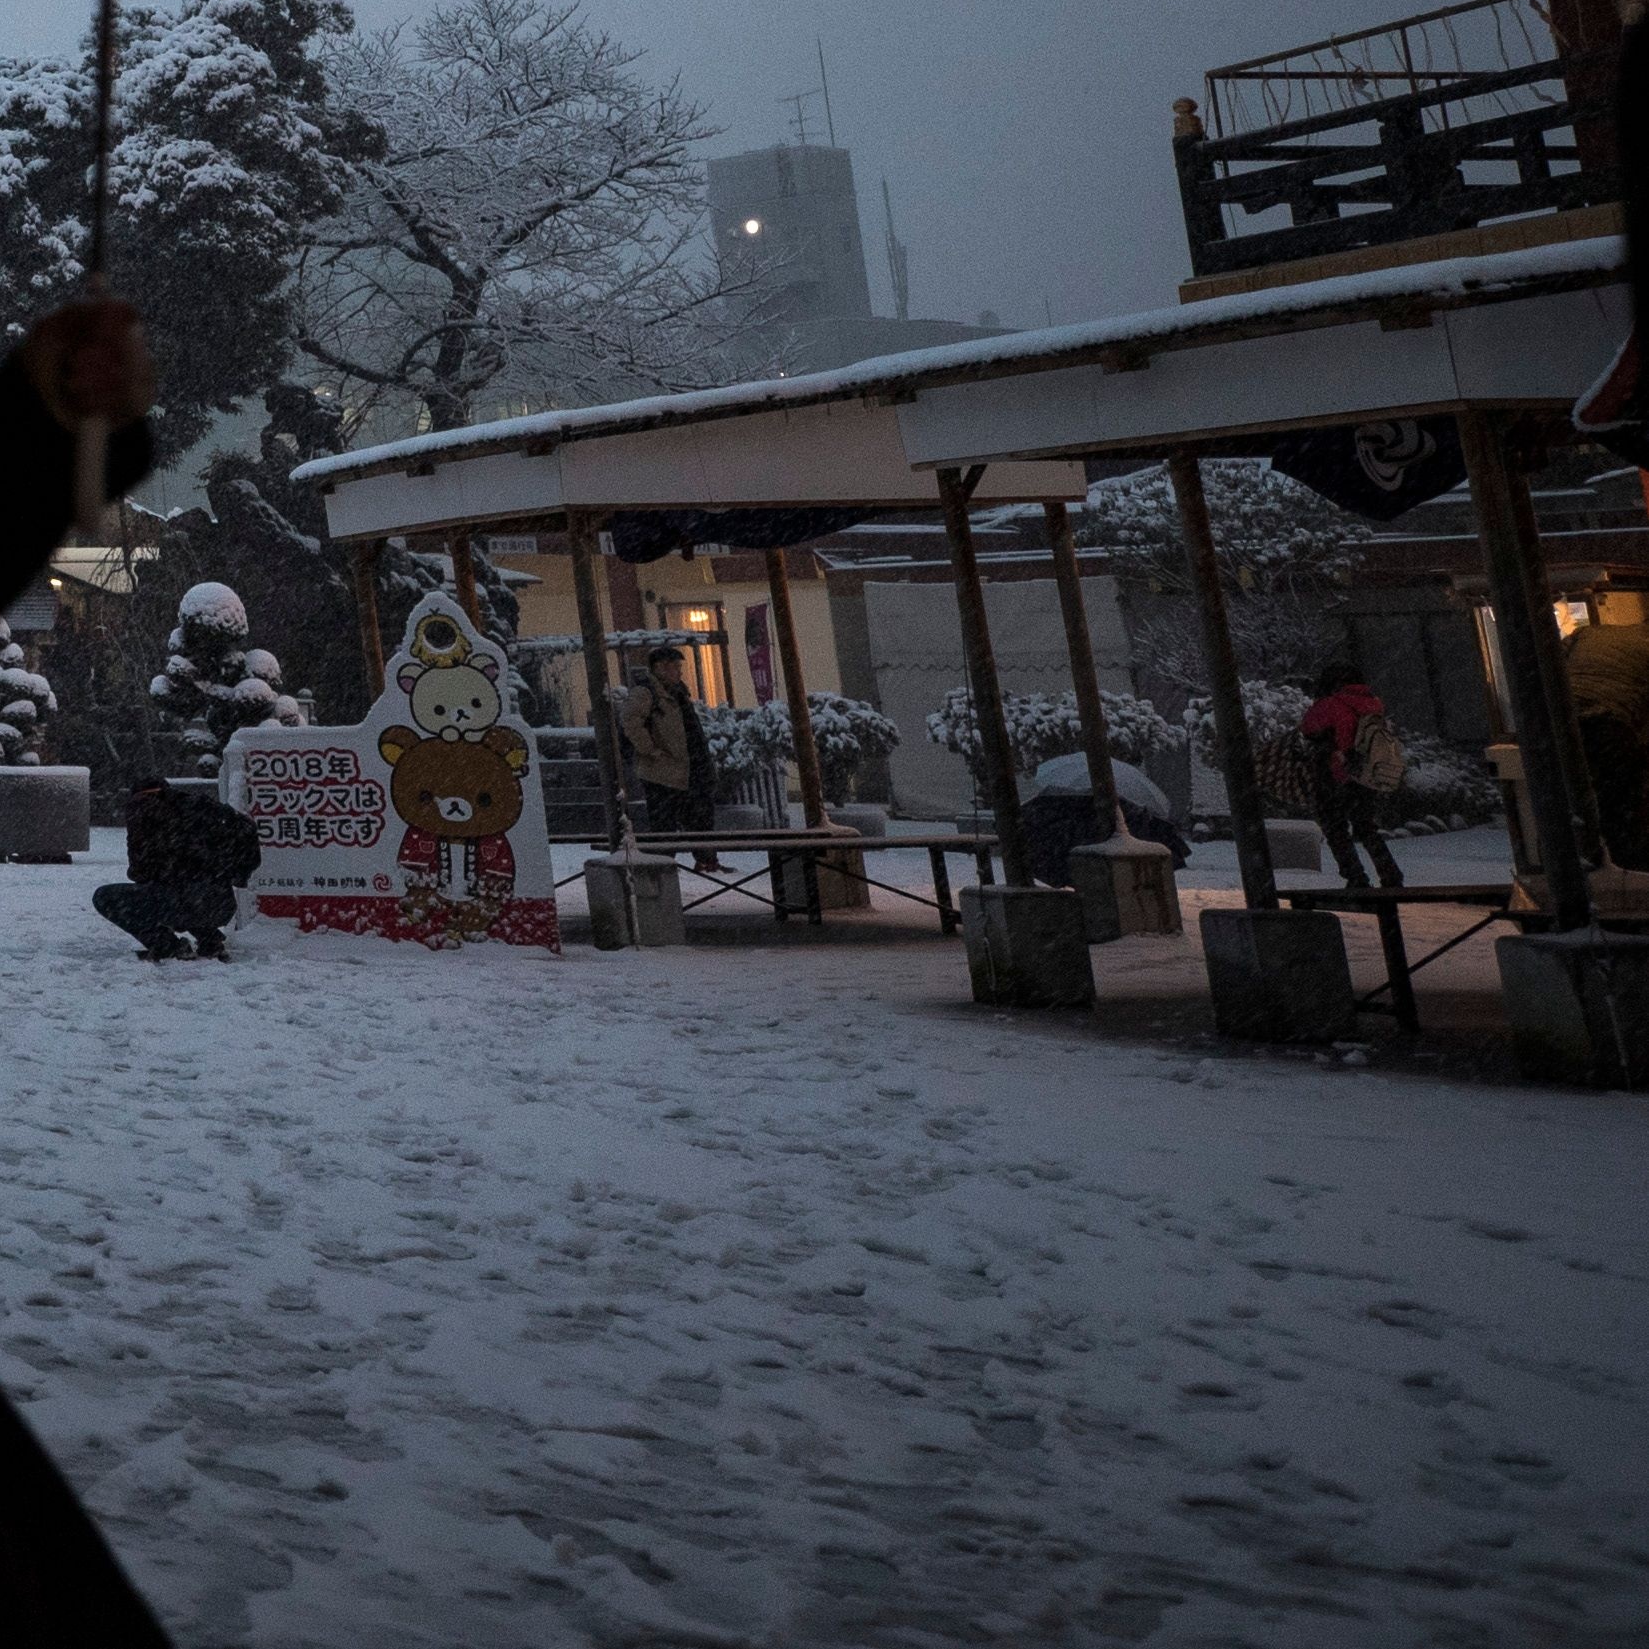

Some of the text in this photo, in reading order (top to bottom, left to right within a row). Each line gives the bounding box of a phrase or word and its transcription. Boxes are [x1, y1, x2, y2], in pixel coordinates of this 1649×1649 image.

[251, 755, 353, 779] 2018年
[256, 816, 378, 840] 5周年です
